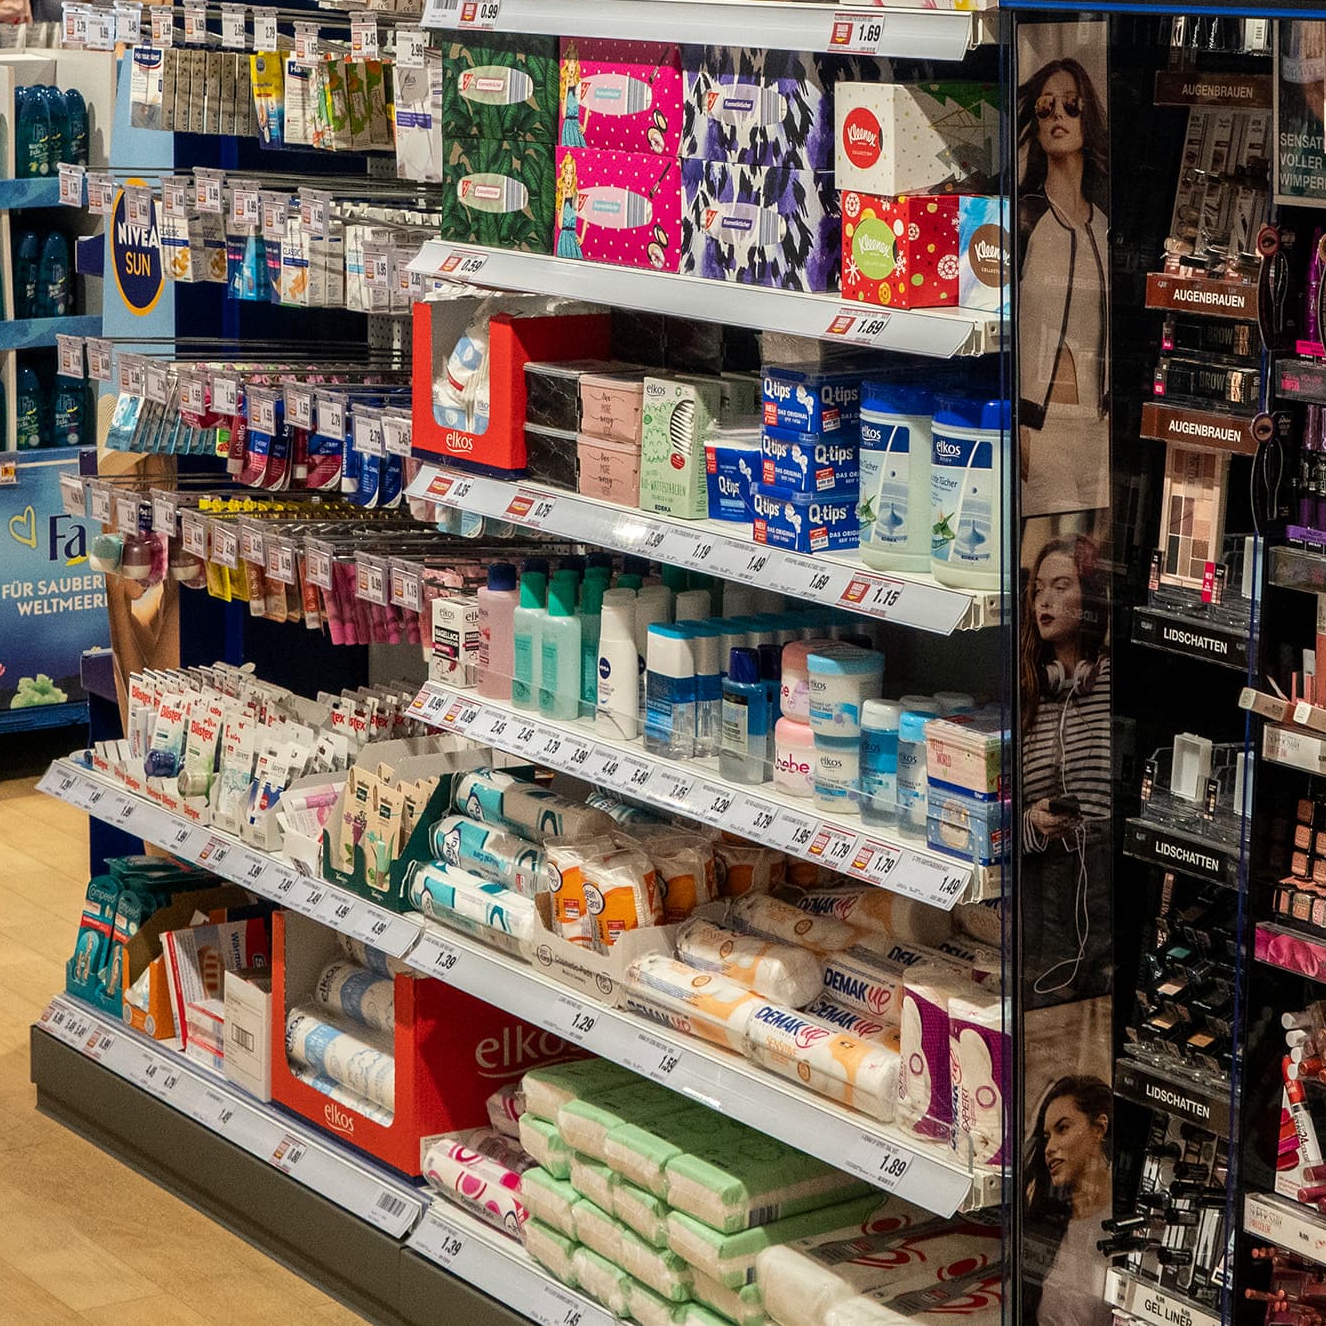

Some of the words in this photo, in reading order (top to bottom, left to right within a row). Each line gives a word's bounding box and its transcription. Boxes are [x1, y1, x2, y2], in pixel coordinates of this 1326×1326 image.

[481, 4, 498, 19] 0.99
[859, 24, 881, 41] 1.69
[410, 43, 423, 58] 2.99
[1181, 82, 1254, 100] AUGENBRAUEN
[847, 125, 876, 147] Kleenex
[1279, 153, 1323, 171] VOLLER
[117, 222, 159, 248] NIVEA
[283, 247, 302, 257] CLASSIC
[858, 234, 890, 258] Kleenex
[125, 252, 151, 276] SUN
[461, 258, 482, 274] 0.59
[1173, 289, 1245, 308] AUGENBRAUEN
[856, 319, 883, 335] 1.69
[646, 383, 666, 395] elkos
[764, 377, 790, 401] Q-tips
[821, 385, 858, 406] Q-tips
[1168, 420, 1241, 442] AUGENBRAUEN
[446, 432, 473, 450] elkos
[453, 482, 469, 497] 0.35
[534, 502, 550, 518] 0.75
[654, 504, 671, 513] EDEKA
[49, 514, 87, 561] Fa
[692, 543, 712, 560] 1.19
[747, 557, 766, 571] 1.49
[2, 581, 33, 599] FÜR
[38, 575, 106, 595] SAUBER
[808, 575, 830, 590] 1.69
[17, 594, 107, 616] WELTMEER
[872, 588, 900, 606] 1.15
[435, 628, 459, 642] NAGELLACK
[1163, 627, 1228, 654] LIDSCHATTEN
[161, 704, 182, 723] Blistex
[190, 719, 215, 742] Blistex
[490, 720, 507, 734] 2.45
[543, 739, 560, 754] 3.79
[570, 748, 588, 763] 3.99
[601, 761, 619, 776] 4.49
[775, 753, 810, 774] bebe
[710, 797, 730, 813] 3.29
[753, 812, 773, 829] 3.79
[791, 827, 812, 844] 1.95
[830, 841, 850, 858] 1.79
[1155, 841, 1219, 871] LIDSCHATTEN
[874, 856, 895, 873] 1.79
[938, 878, 960, 895] 1.49
[435, 951, 457, 969] 1.39
[571, 1013, 594, 1032] 1.29
[657, 1057, 676, 1073] 1.59
[1146, 1084, 1210, 1119] LIDSCHATTEN
[879, 1154, 907, 1176] 1.89
[441, 1234, 462, 1258] 1.39
[1145, 1299, 1162, 1317] GEL
